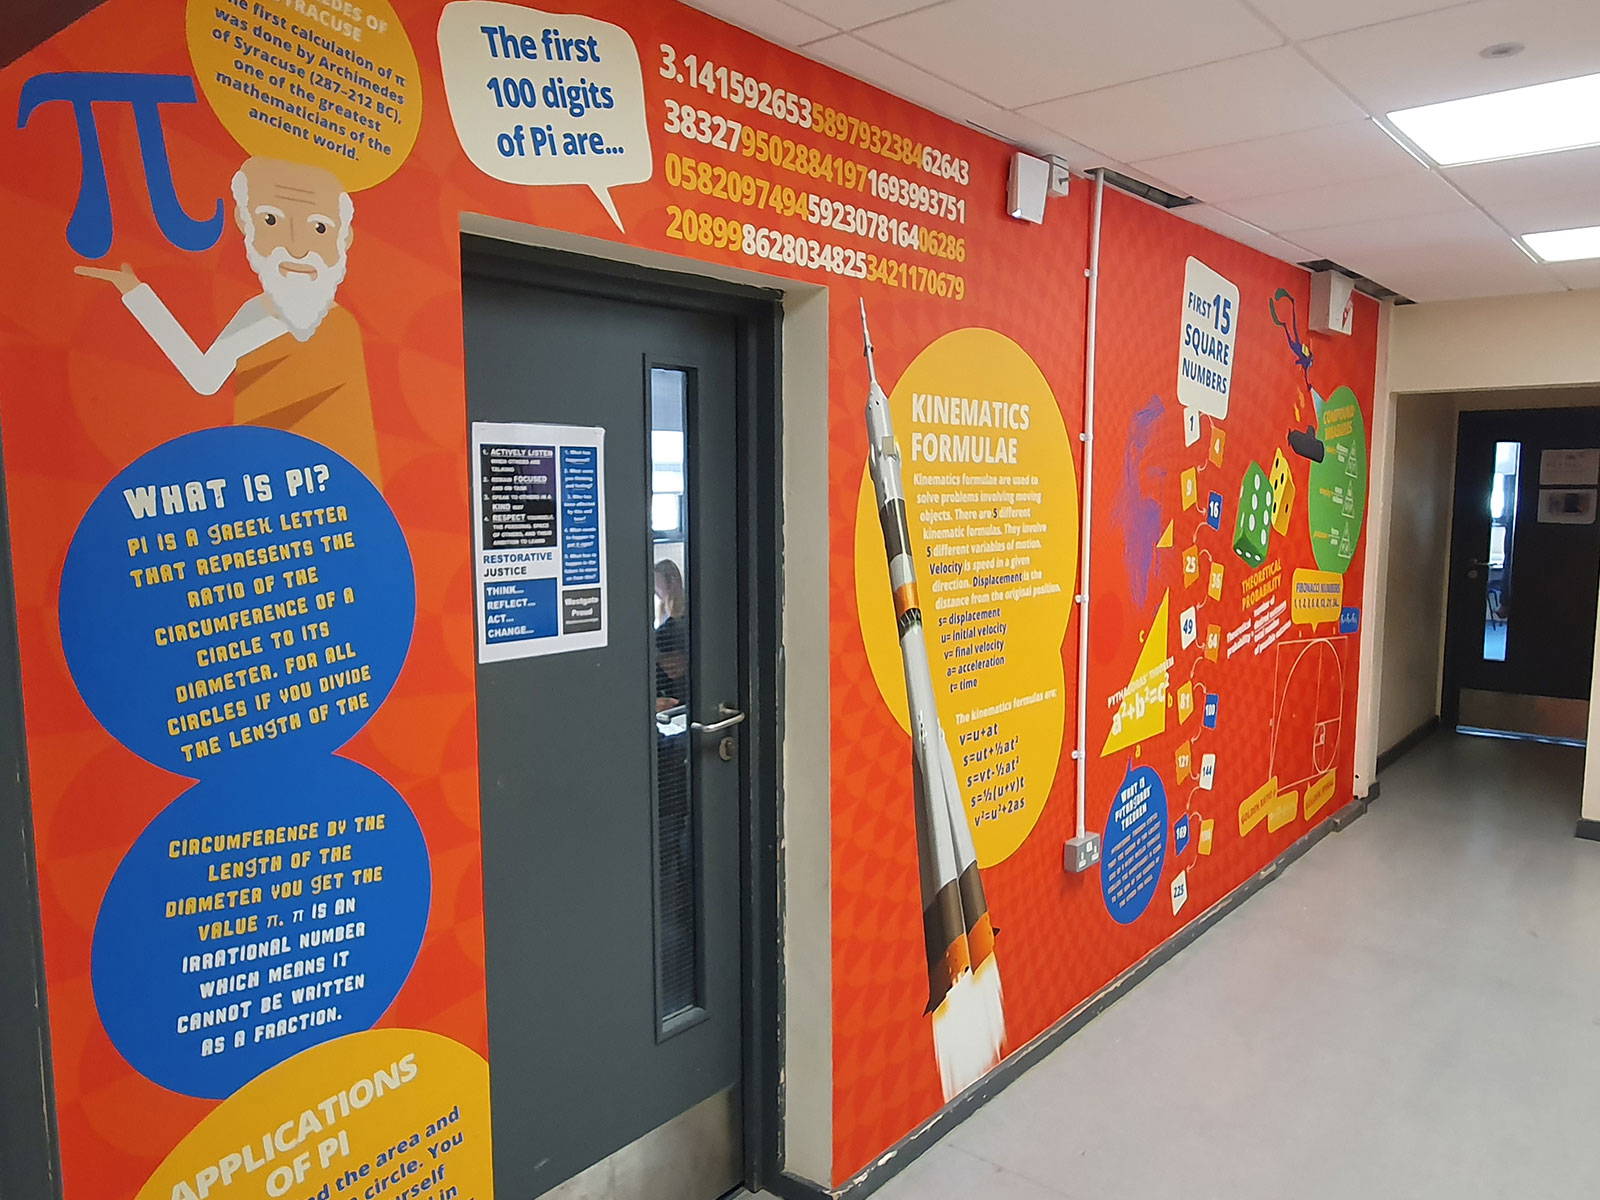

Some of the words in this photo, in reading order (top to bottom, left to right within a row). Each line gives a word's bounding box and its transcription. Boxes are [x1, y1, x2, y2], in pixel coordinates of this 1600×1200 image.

[254, 3, 286, 29] first
[291, 26, 373, 72] calculation
[378, 66, 393, 80] of
[366, 15, 388, 33] OF
[480, 26, 537, 60] The
[541, 29, 600, 62] first
[212, 29, 230, 42] of
[234, 36, 304, 78] Syracuse
[216, 9, 247, 31] was
[253, 26, 292, 51] done
[297, 44, 314, 64] by
[319, 57, 404, 104] Archimedes
[217, 72, 346, 136] mathematicians
[351, 130, 365, 142] of
[369, 138, 392, 155] the
[234, 59, 264, 80] one
[269, 76, 286, 88] of
[290, 83, 315, 103] the
[319, 98, 381, 132] greatest
[487, 77, 536, 108] 100
[543, 78, 614, 118] digits
[249, 108, 309, 140] ancient
[314, 134, 359, 160] world.
[497, 125, 525, 157] of
[530, 125, 557, 156] Pi
[562, 131, 624, 154] are...
[1188, 292, 1211, 319] FIRST
[1213, 294, 1232, 335] 15
[1184, 323, 1229, 366] SQUARE
[1182, 358, 1227, 395] NUMBERS
[912, 393, 1030, 430] KINEMATICS
[1189, 416, 1194, 432] 1
[912, 432, 1017, 464] FORMULAE
[123, 479, 226, 519] WHAT
[243, 474, 273, 502] IS
[286, 465, 330, 496] PI?
[1209, 501, 1219, 519] 16
[128, 536, 148, 556] PI
[157, 533, 176, 551] IS
[186, 528, 199, 547] A
[280, 505, 348, 532] LETTER
[130, 562, 186, 588] THAT
[196, 540, 314, 576] REPRESENTS
[321, 531, 355, 553] THE
[484, 552, 552, 563] RESTORATIVE
[484, 566, 527, 577] JUSTICE
[930, 561, 962, 575] Velocity
[1185, 556, 1196, 573] 25
[187, 581, 245, 608] RATIO
[253, 575, 275, 595] OF
[283, 566, 318, 588] THE
[973, 573, 1022, 588] Displacement
[155, 597, 308, 646] CIRCUMFERENCE
[315, 591, 335, 610] OF
[343, 587, 355, 603] A
[939, 617, 947, 626] s=
[949, 608, 1000, 625] displacement
[941, 634, 951, 643] u=
[953, 627, 976, 641] initial
[978, 623, 1007, 636] velocity
[1183, 618, 1193, 635] 49
[196, 636, 263, 667] CIRCLE
[271, 629, 295, 649] TO
[301, 621, 330, 640] ITS
[944, 650, 953, 659] v=
[955, 644, 972, 658] final
[975, 640, 1004, 653] velocity
[947, 667, 956, 676] a=
[958, 655, 1004, 674] acceleration
[176, 665, 278, 704] DIAMETER.
[285, 651, 318, 674] FOR
[325, 643, 356, 664] ALL
[950, 682, 958, 693] t=
[960, 678, 978, 690] time
[167, 700, 247, 736] CIRCLES
[255, 693, 271, 711] IF
[279, 682, 312, 704] YOU
[319, 665, 372, 692] DIVIDE
[1205, 703, 1216, 716] 100
[181, 736, 221, 762] THE
[309, 704, 329, 724] OF
[336, 692, 369, 716] THE
[1203, 765, 1212, 777] 144
[168, 822, 319, 858] CIRCUMFERENCE
[327, 820, 346, 836] BY
[354, 814, 385, 832] THE
[291, 851, 312, 869] OF
[319, 844, 352, 864] THE
[165, 887, 262, 918] DIAMETER
[271, 880, 303, 899] YOU
[351, 866, 383, 885] THE
[1173, 884, 1184, 898] 225
[198, 915, 258, 941] VALUE
[312, 903, 326, 919] IS
[335, 897, 355, 915] AN
[182, 936, 291, 973] IRRATIONAL
[299, 921, 365, 947] NUMBER
[200, 970, 259, 999] WHICH
[268, 956, 325, 983] MEANS
[333, 951, 350, 968] IT
[177, 1000, 252, 1033] CANNOT
[260, 993, 282, 1014] BE
[292, 973, 365, 1004] WRITTEN
[201, 1036, 225, 1057] AS
[234, 1030, 246, 1048] A
[254, 1006, 342, 1043] FRACTION.
[171, 1053, 418, 1200] APPLICATIONS
[266, 1152, 312, 1198] OF
[317, 1129, 350, 1169] PI
[335, 1163, 370, 1192] the
[376, 1133, 421, 1168] area
[425, 1105, 460, 1138] and
[364, 1159, 424, 1200] circle.
[427, 1132, 464, 1159] You
